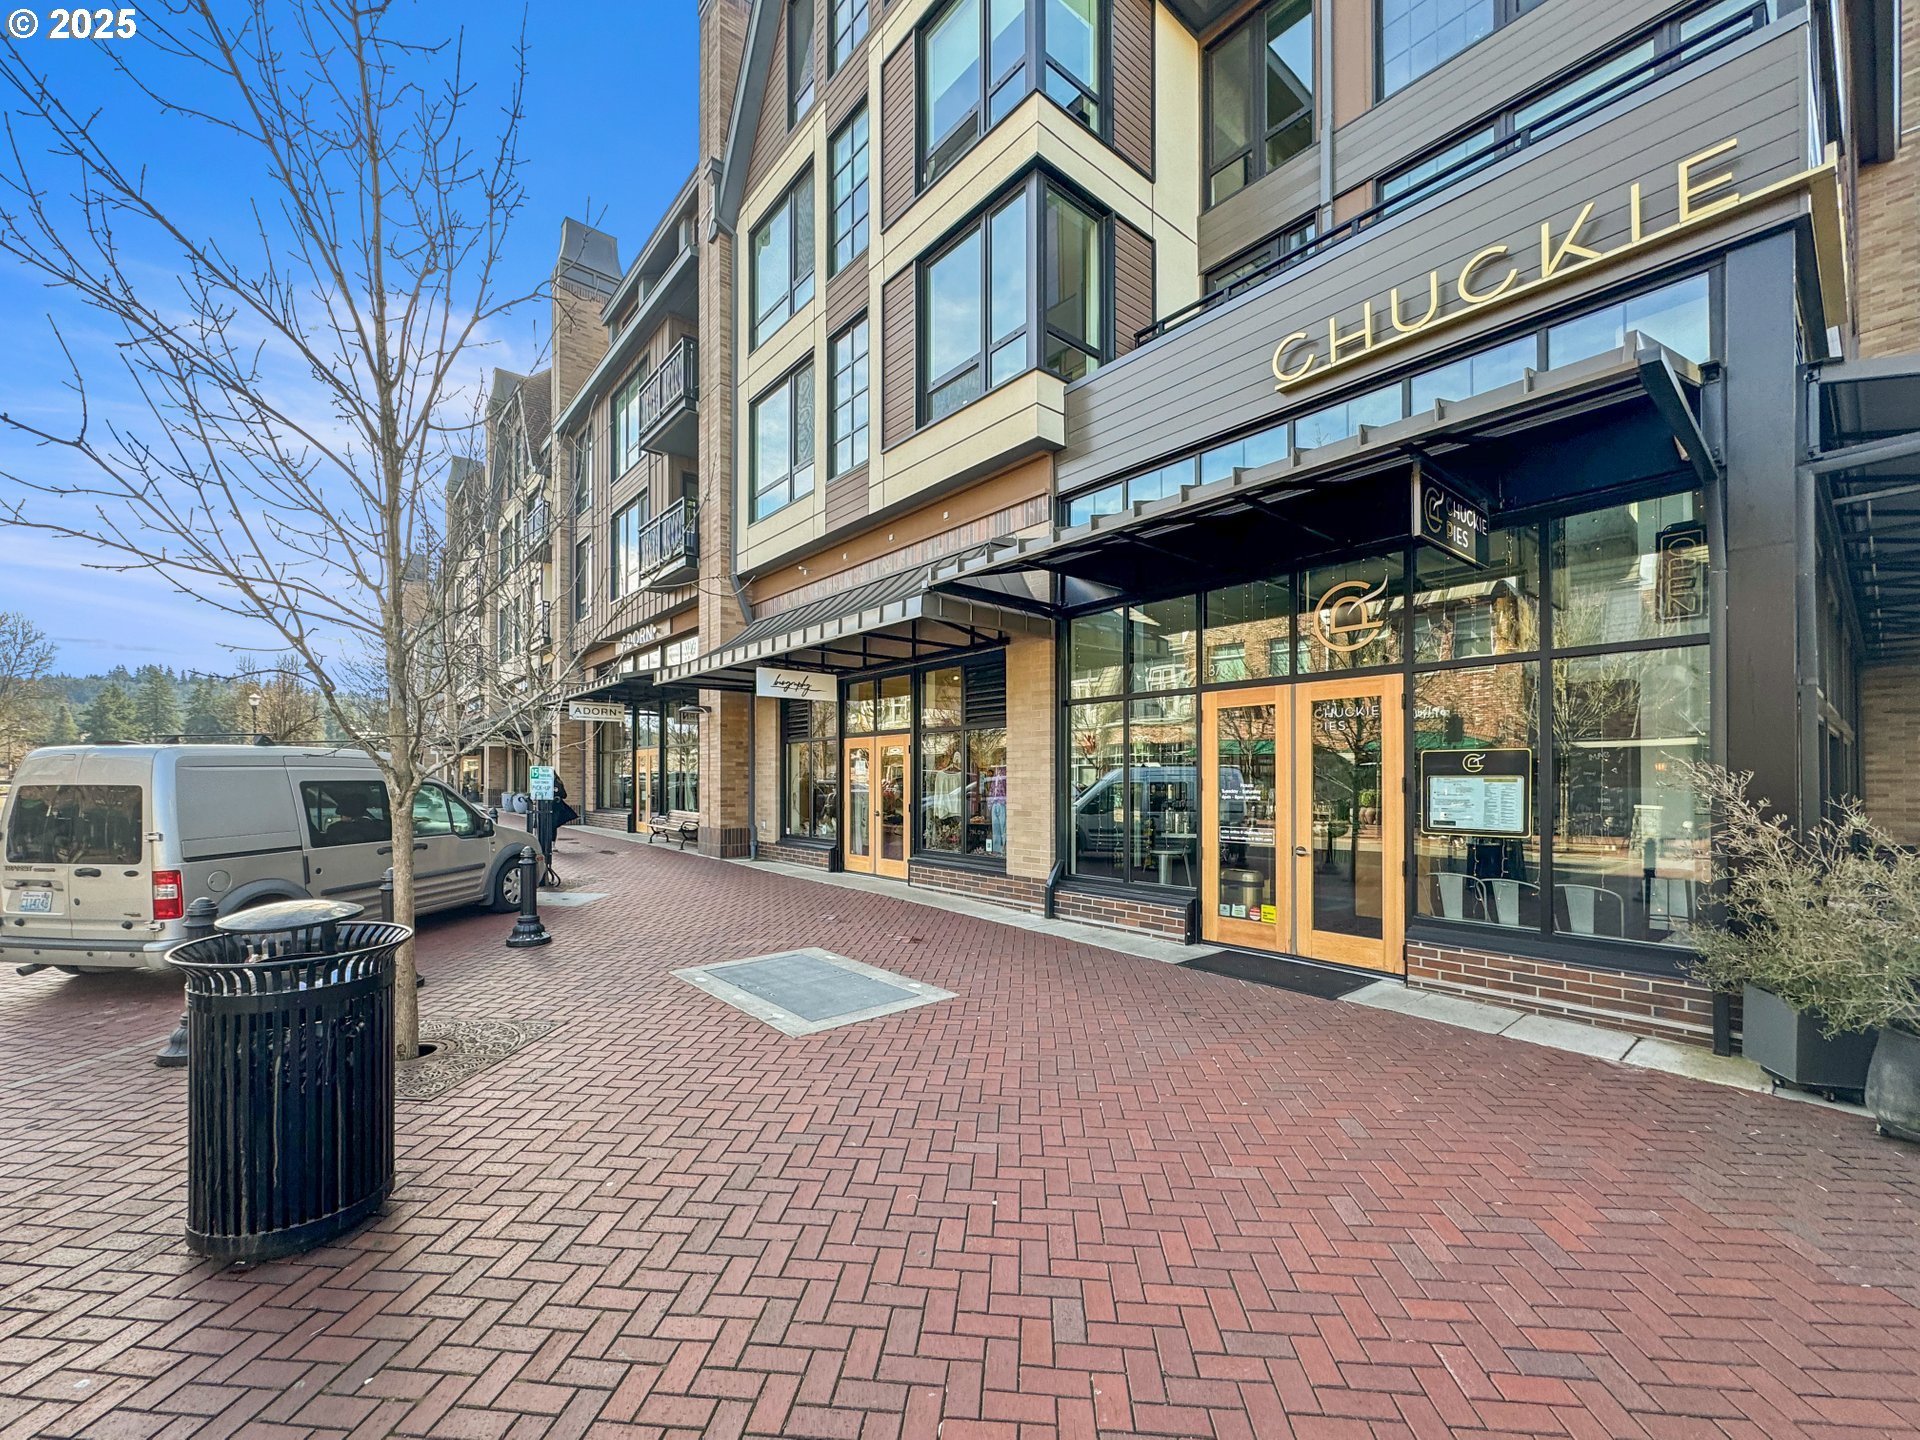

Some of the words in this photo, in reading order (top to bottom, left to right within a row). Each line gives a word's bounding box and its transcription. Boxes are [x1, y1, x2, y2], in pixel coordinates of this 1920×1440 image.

[1272, 138, 1739, 382] CHUCKIE
[1446, 497, 1487, 536] CHUCKIE
[1446, 520, 1469, 548] PIES
[1668, 538, 1697, 617] OPEN
[574, 706, 617, 716] ADORN
[1314, 705, 1379, 719] CHUCKIE
[532, 768, 538, 778] 15
